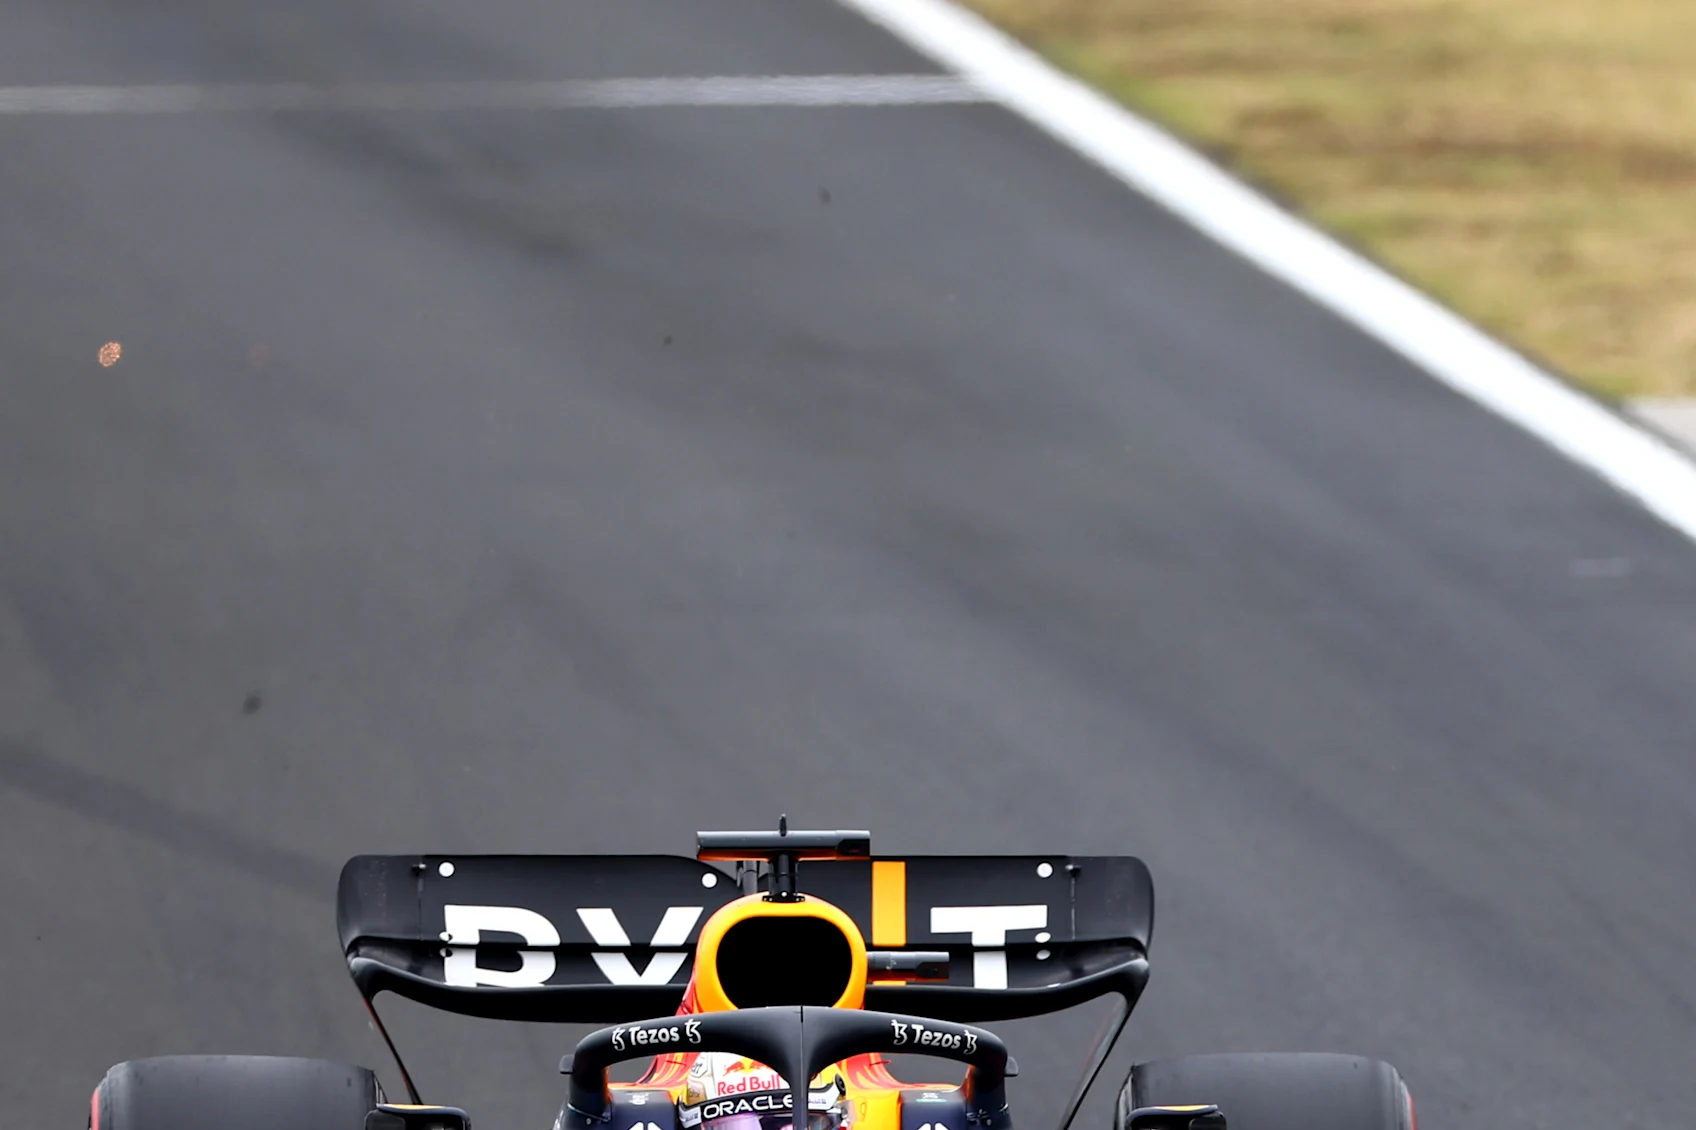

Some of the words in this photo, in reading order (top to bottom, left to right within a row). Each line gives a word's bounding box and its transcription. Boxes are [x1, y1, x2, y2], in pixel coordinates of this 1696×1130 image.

[628, 1026, 680, 1046] Tezos
[911, 1024, 962, 1049] Tezos
[717, 1080, 747, 1097] Red
[750, 1074, 781, 1091] Bull
[703, 1095, 793, 1119] ORACLE
